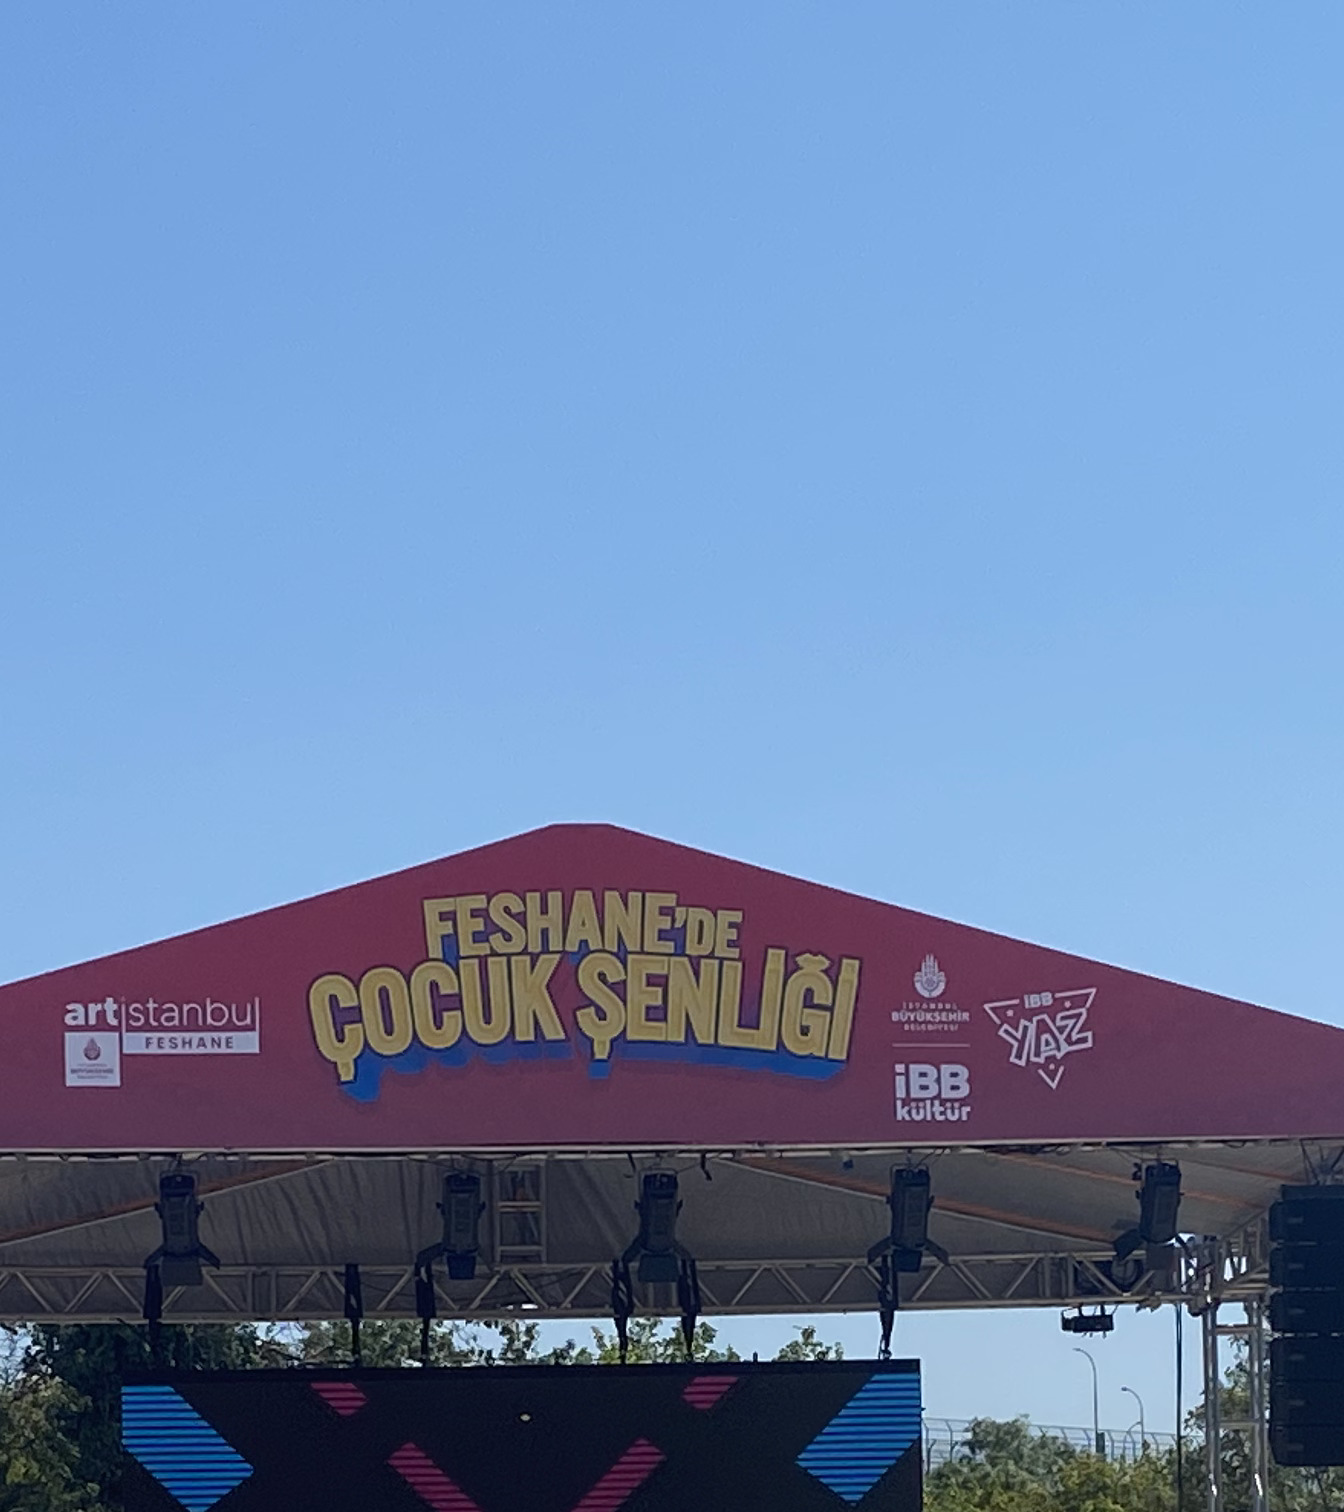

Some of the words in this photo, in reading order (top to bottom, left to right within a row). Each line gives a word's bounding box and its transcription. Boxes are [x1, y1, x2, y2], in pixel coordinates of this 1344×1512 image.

[424, 890, 743, 959] FESHANE'DE
[309, 953, 566, 1082] ÇOCUK
[891, 1010, 970, 1022] BÜYÜKŞEHİR
[145, 1036, 234, 1049] FESHANE
[998, 1008, 1093, 1067] YAZ
[896, 1100, 971, 1121] kültür
